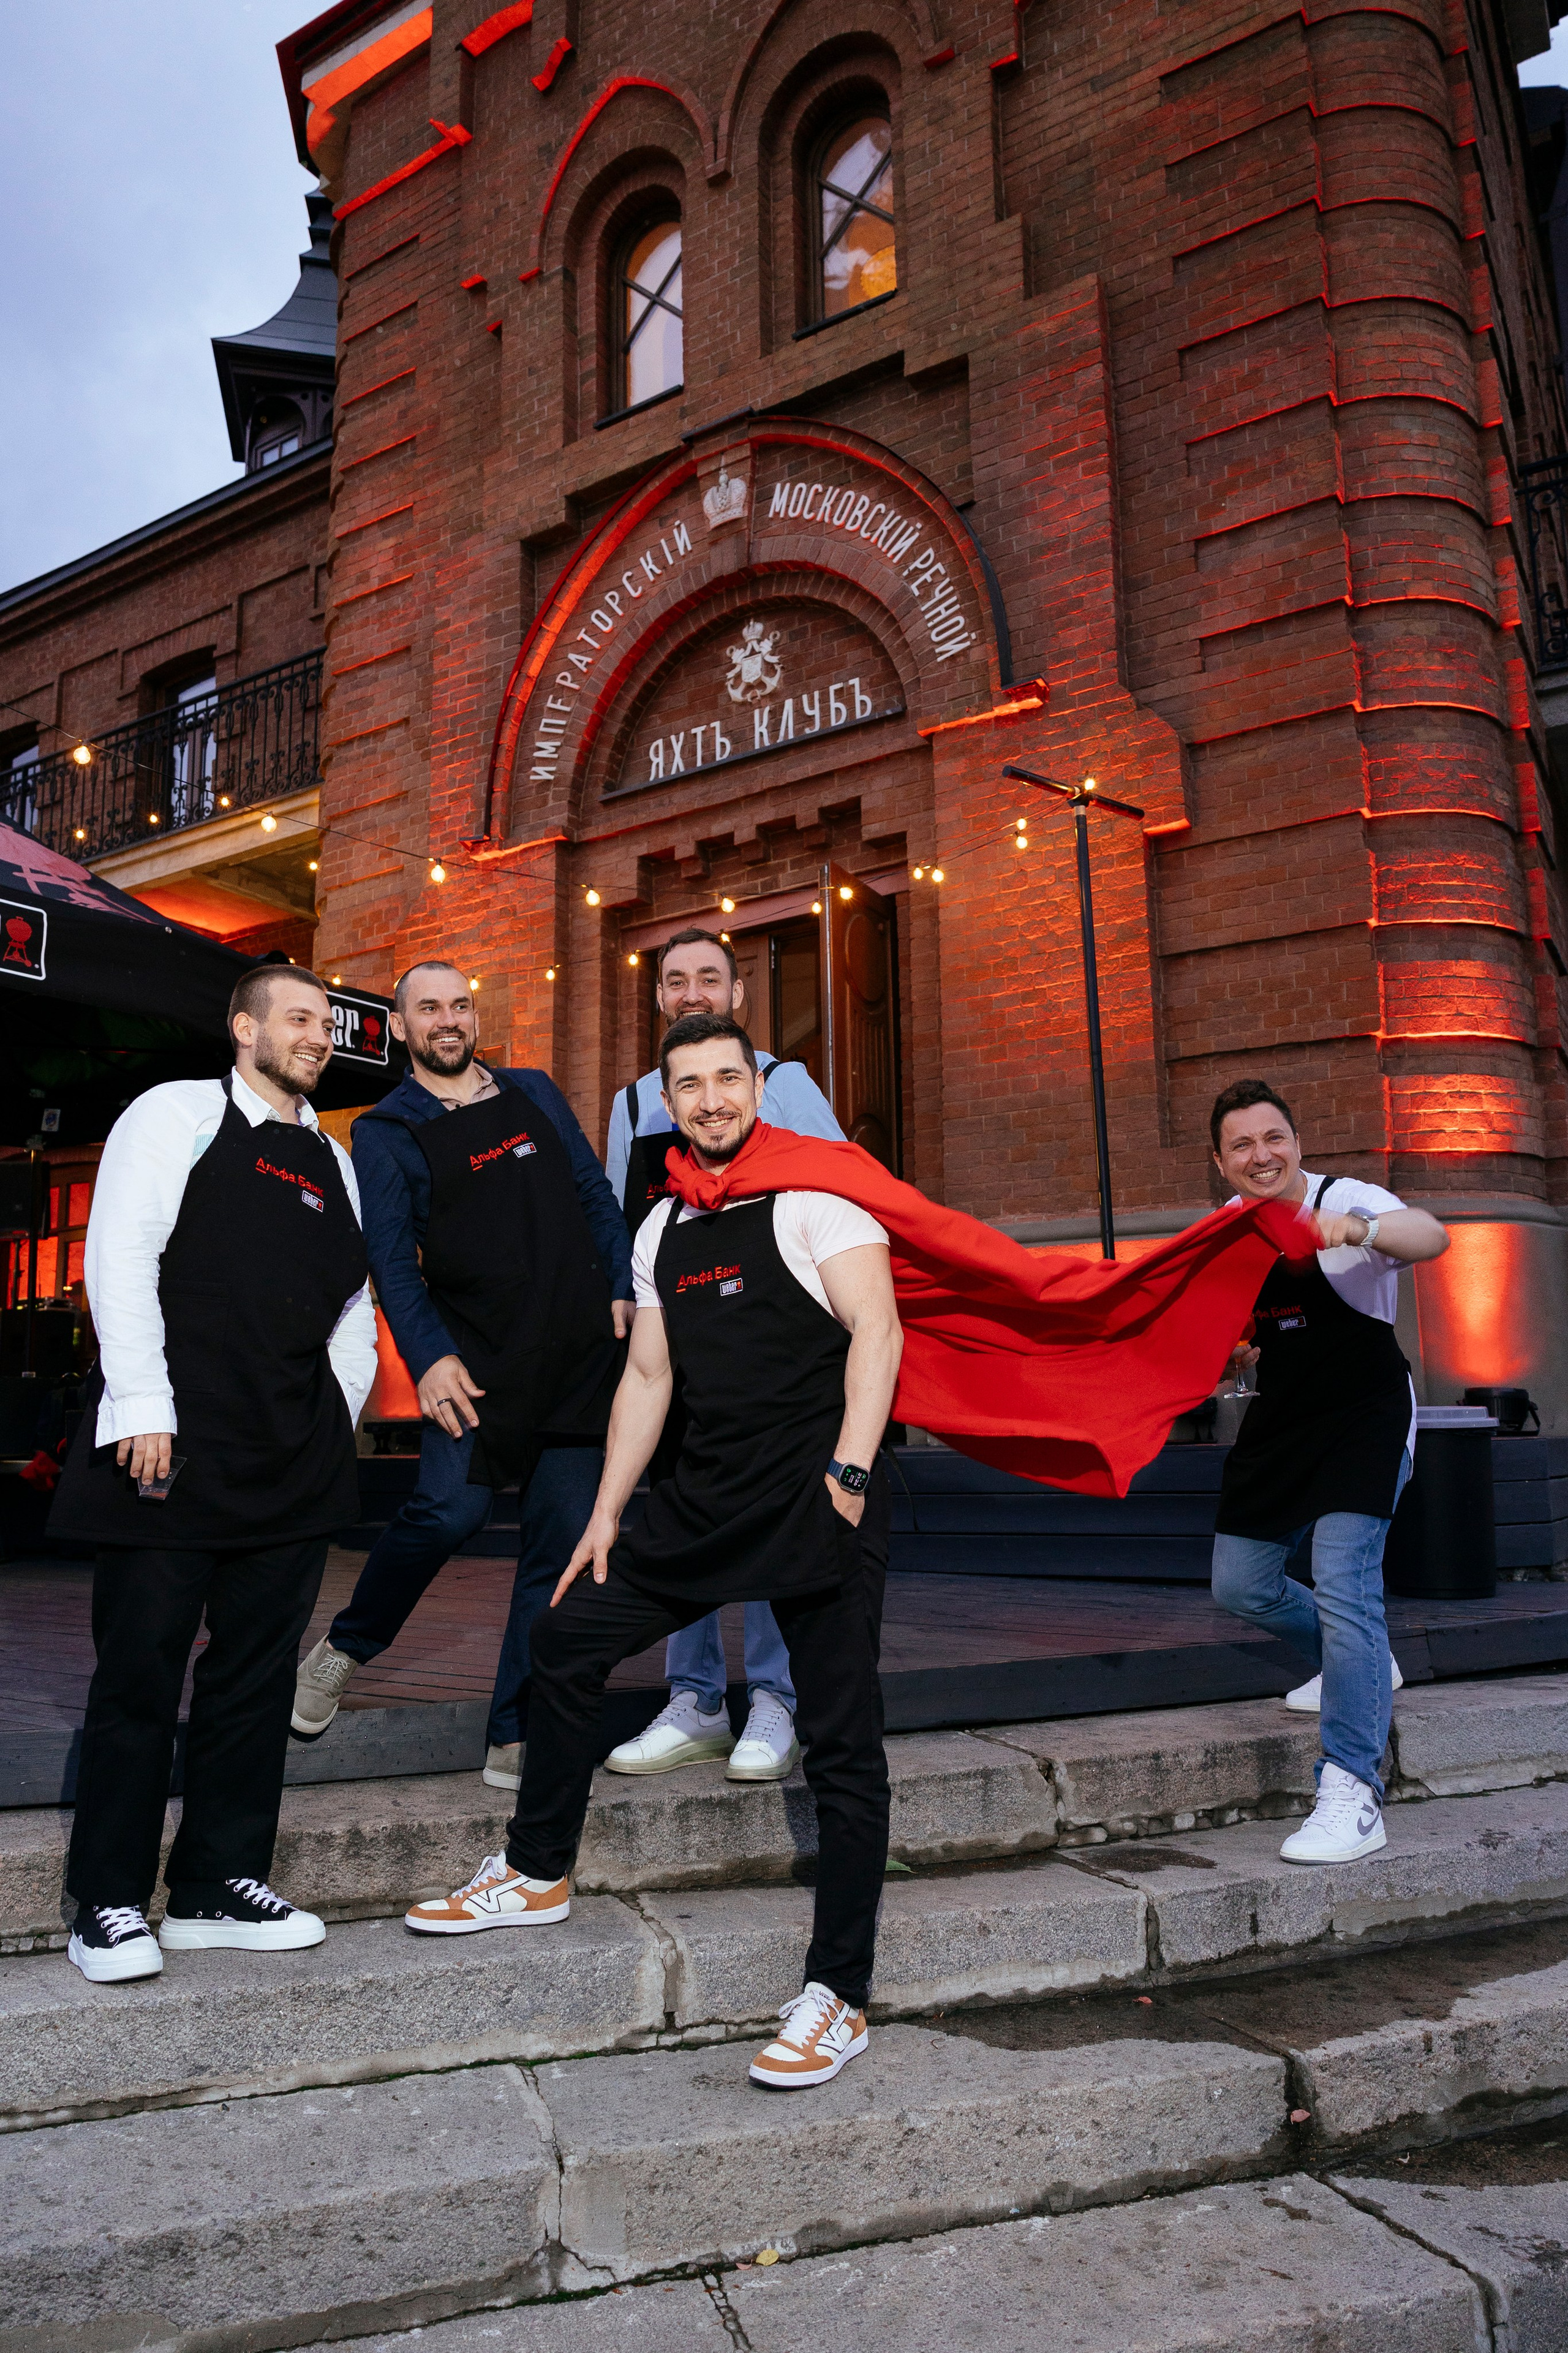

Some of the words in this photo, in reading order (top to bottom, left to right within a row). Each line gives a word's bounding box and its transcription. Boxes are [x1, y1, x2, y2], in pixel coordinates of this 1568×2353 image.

[529, 519, 693, 780] ИМПЕРАТОРСКІЙ
[768, 482, 922, 564] МОСКОВСКІЙ
[902, 547, 977, 662] РЕЧНОЙ
[649, 720, 731, 782] ЯХТЪ
[753, 677, 872, 750] КЛУБЪ
[469, 1147, 505, 1168] Альфа
[501, 1132, 531, 1150] Банк
[516, 1144, 532, 1156] weber
[255, 1157, 296, 1184] Альфа
[298, 1174, 325, 1198] Банк
[304, 1192, 318, 1208] weber
[676, 1270, 713, 1290] Альфа
[714, 1263, 742, 1280] Банк
[722, 1281, 737, 1294] weber
[1270, 1304, 1303, 1318] Банк
[1281, 1319, 1299, 1329] weber
